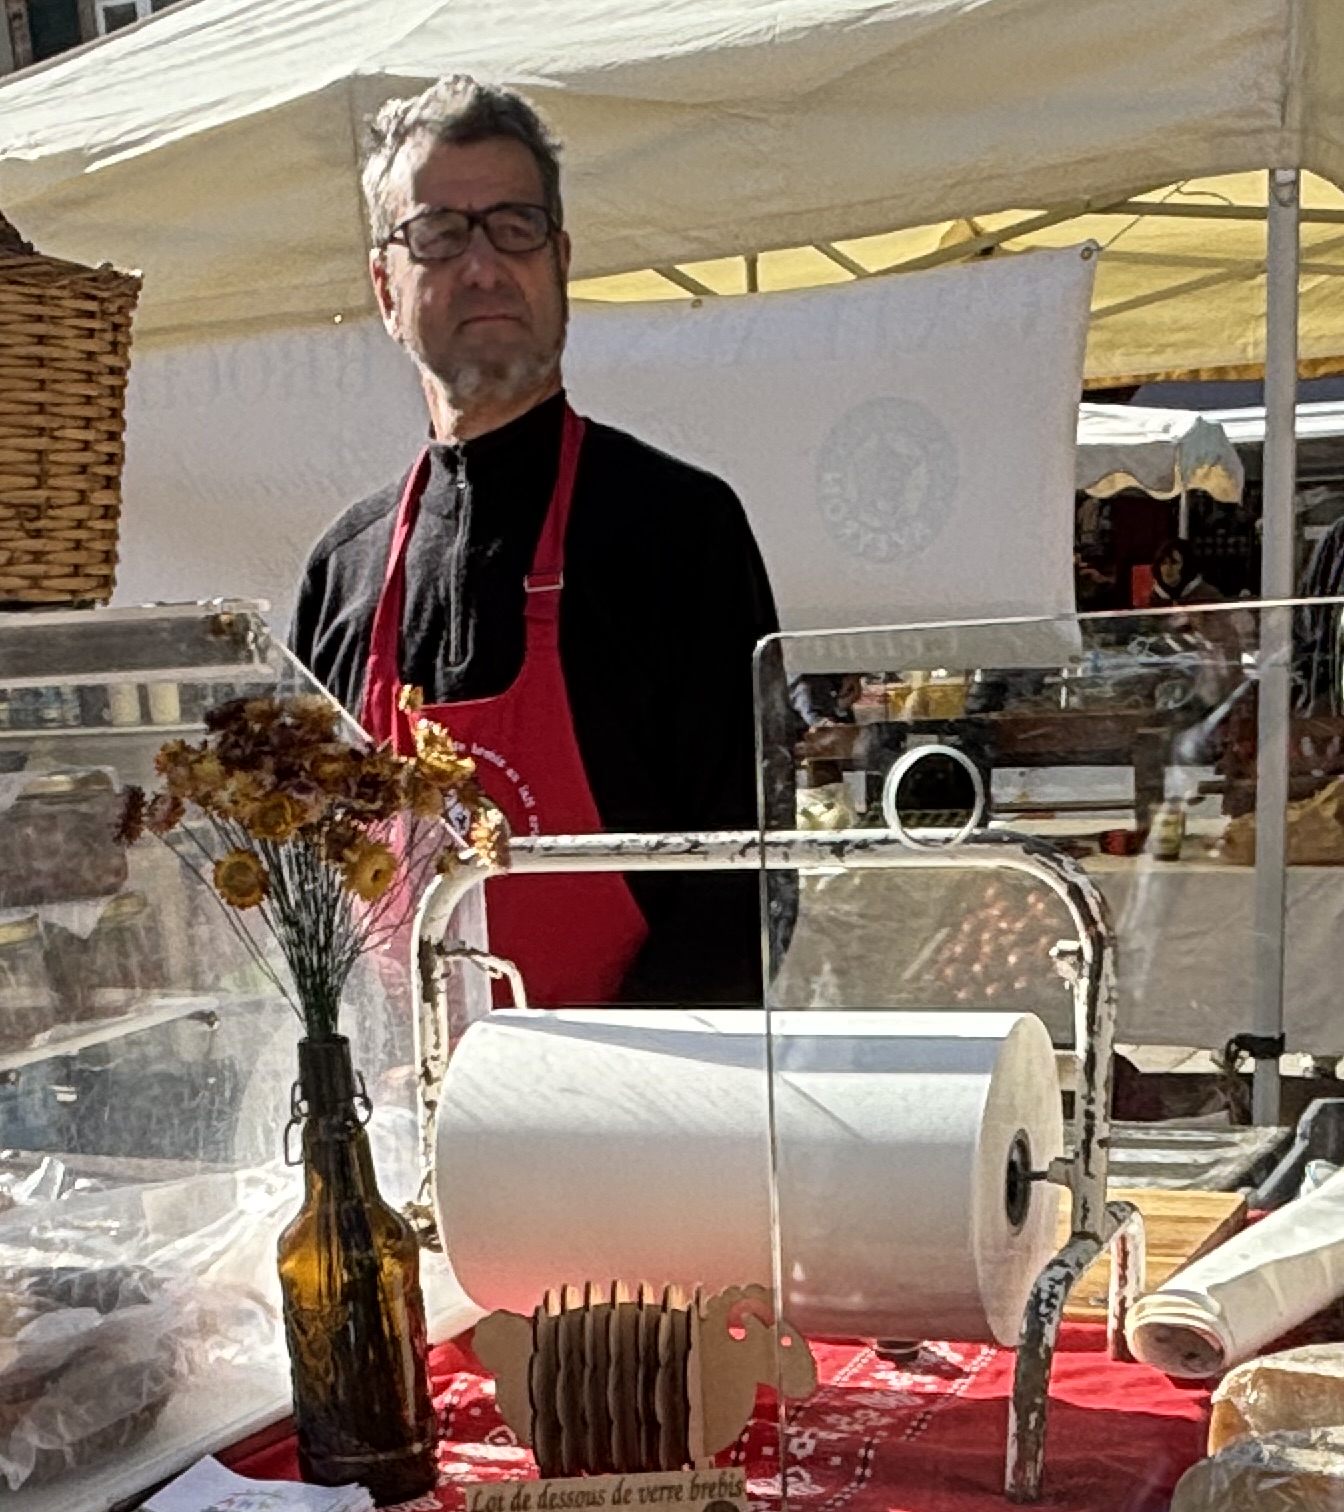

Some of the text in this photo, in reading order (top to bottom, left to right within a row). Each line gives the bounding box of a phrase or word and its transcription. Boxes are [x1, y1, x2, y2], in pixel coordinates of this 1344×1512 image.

[510, 1483, 533, 1512] de
[536, 1482, 606, 1511] dessous
[611, 1476, 634, 1506] de
[638, 1483, 684, 1505] verre
[689, 1470, 744, 1503] brebis
